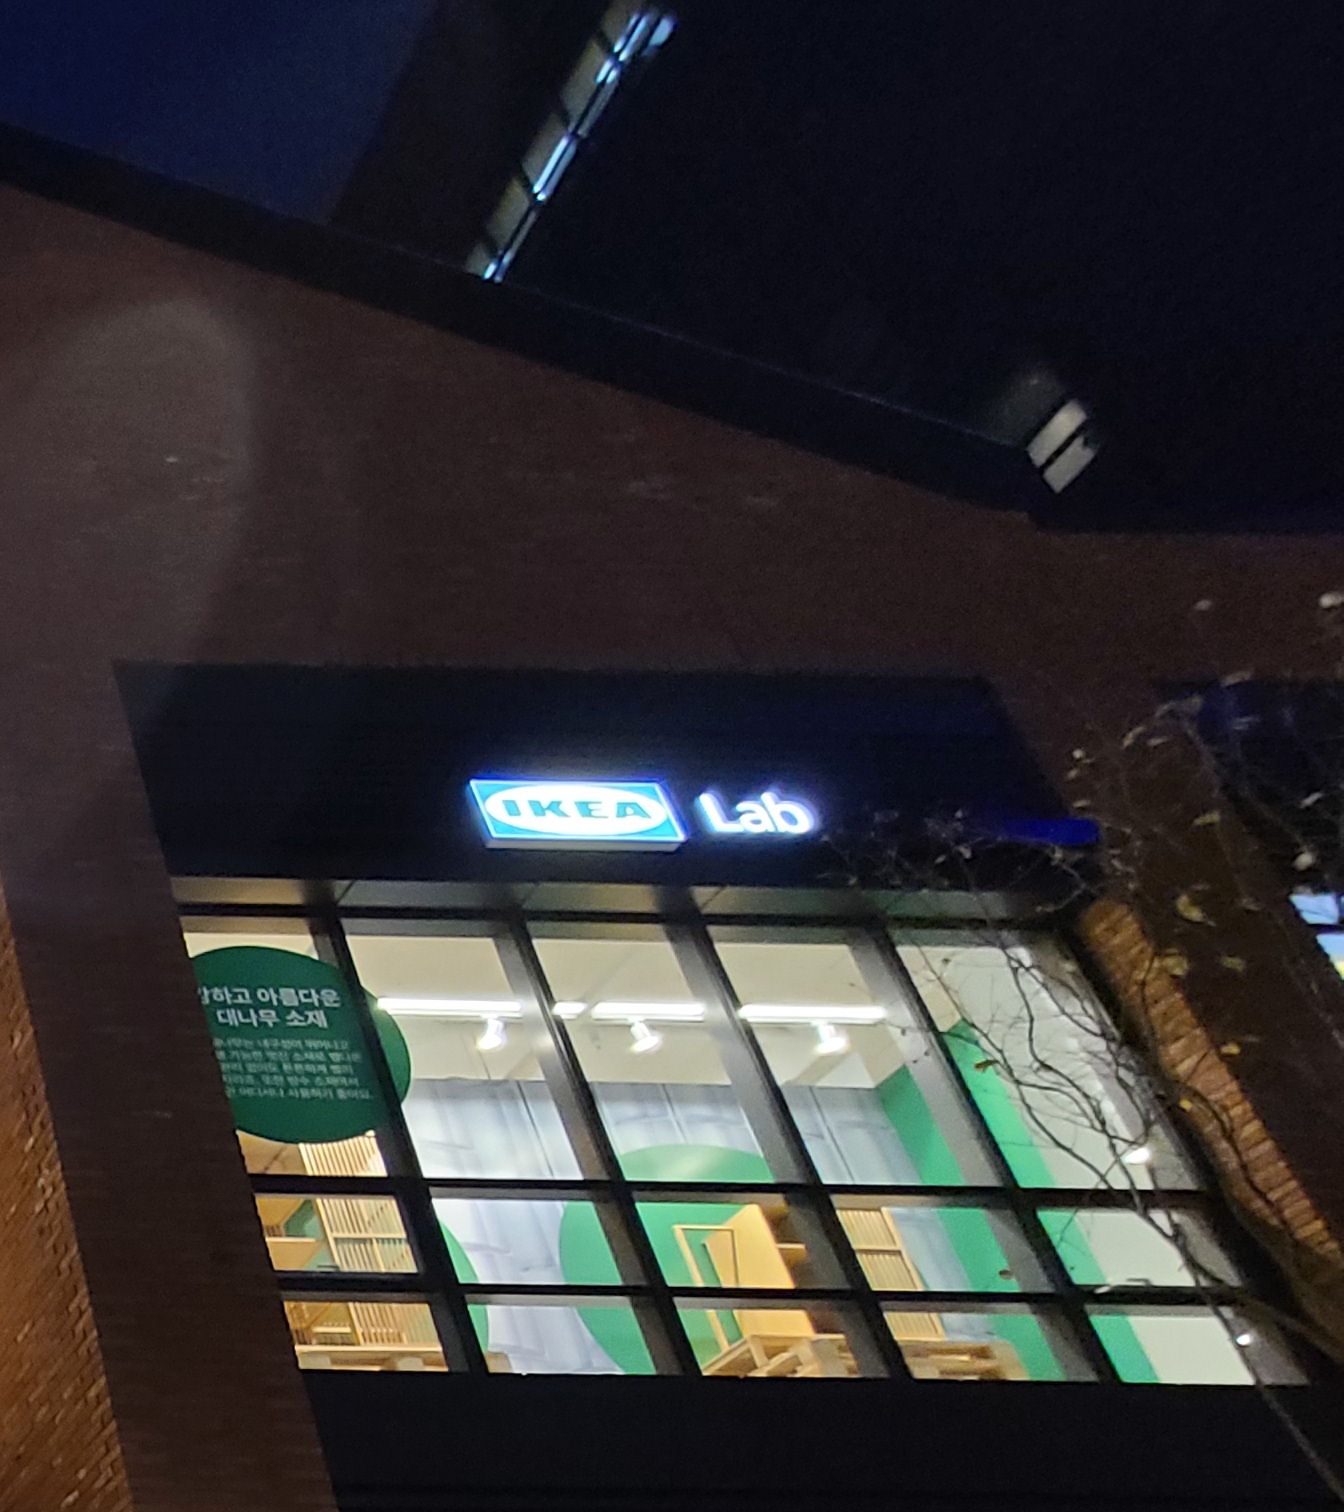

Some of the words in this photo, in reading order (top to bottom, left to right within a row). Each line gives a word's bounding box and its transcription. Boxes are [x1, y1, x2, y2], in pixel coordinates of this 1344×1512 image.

[500, 798, 654, 820] IKEA
[697, 790, 814, 834] Lab
[256, 987, 341, 1007] 아름다운
[216, 1008, 280, 1028] 대나무
[285, 1009, 329, 1029] 소재
